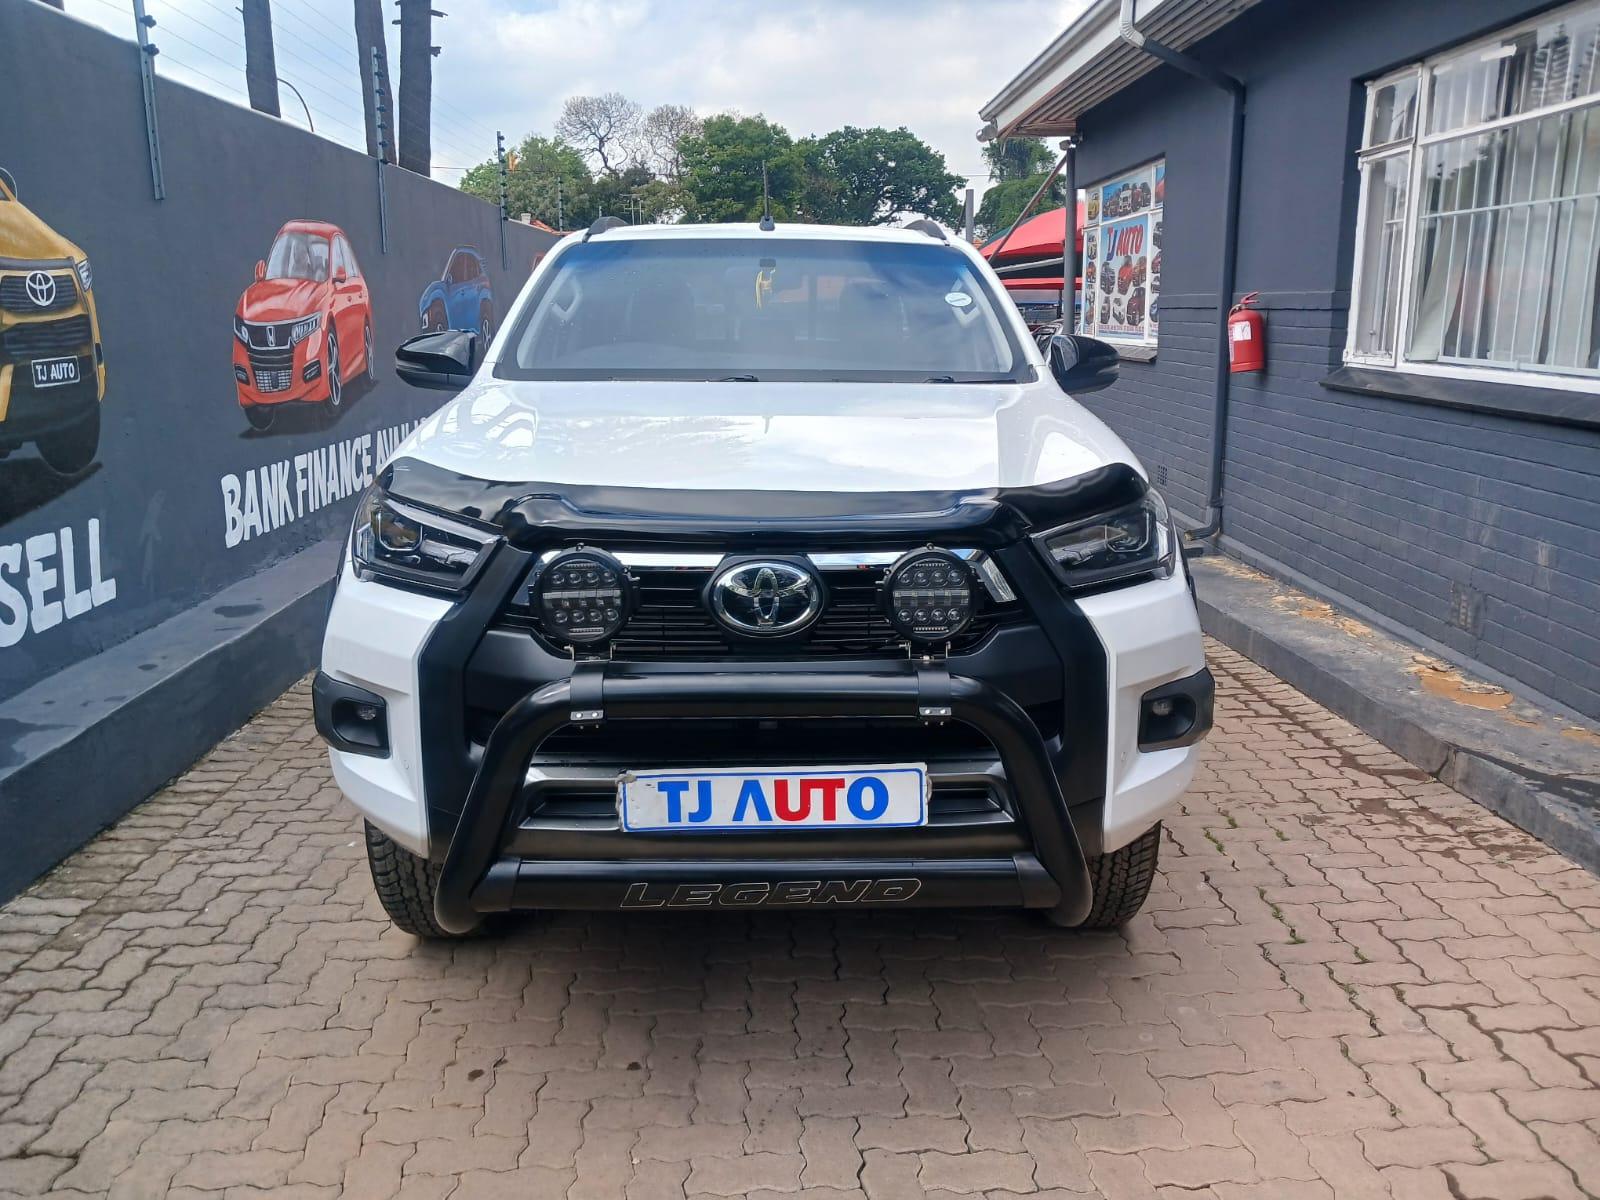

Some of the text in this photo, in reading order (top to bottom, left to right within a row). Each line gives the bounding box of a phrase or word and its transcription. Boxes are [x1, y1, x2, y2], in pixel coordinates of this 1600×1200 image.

[1116, 224, 1144, 256] AUTO
[35, 362, 75, 381] TJ AUTO
[221, 459, 295, 548] BANK
[294, 433, 373, 518] FINANCE
[0, 518, 117, 648] SELL
[657, 776, 889, 823] TJ AUTO
[620, 878, 921, 908] LEGEND
